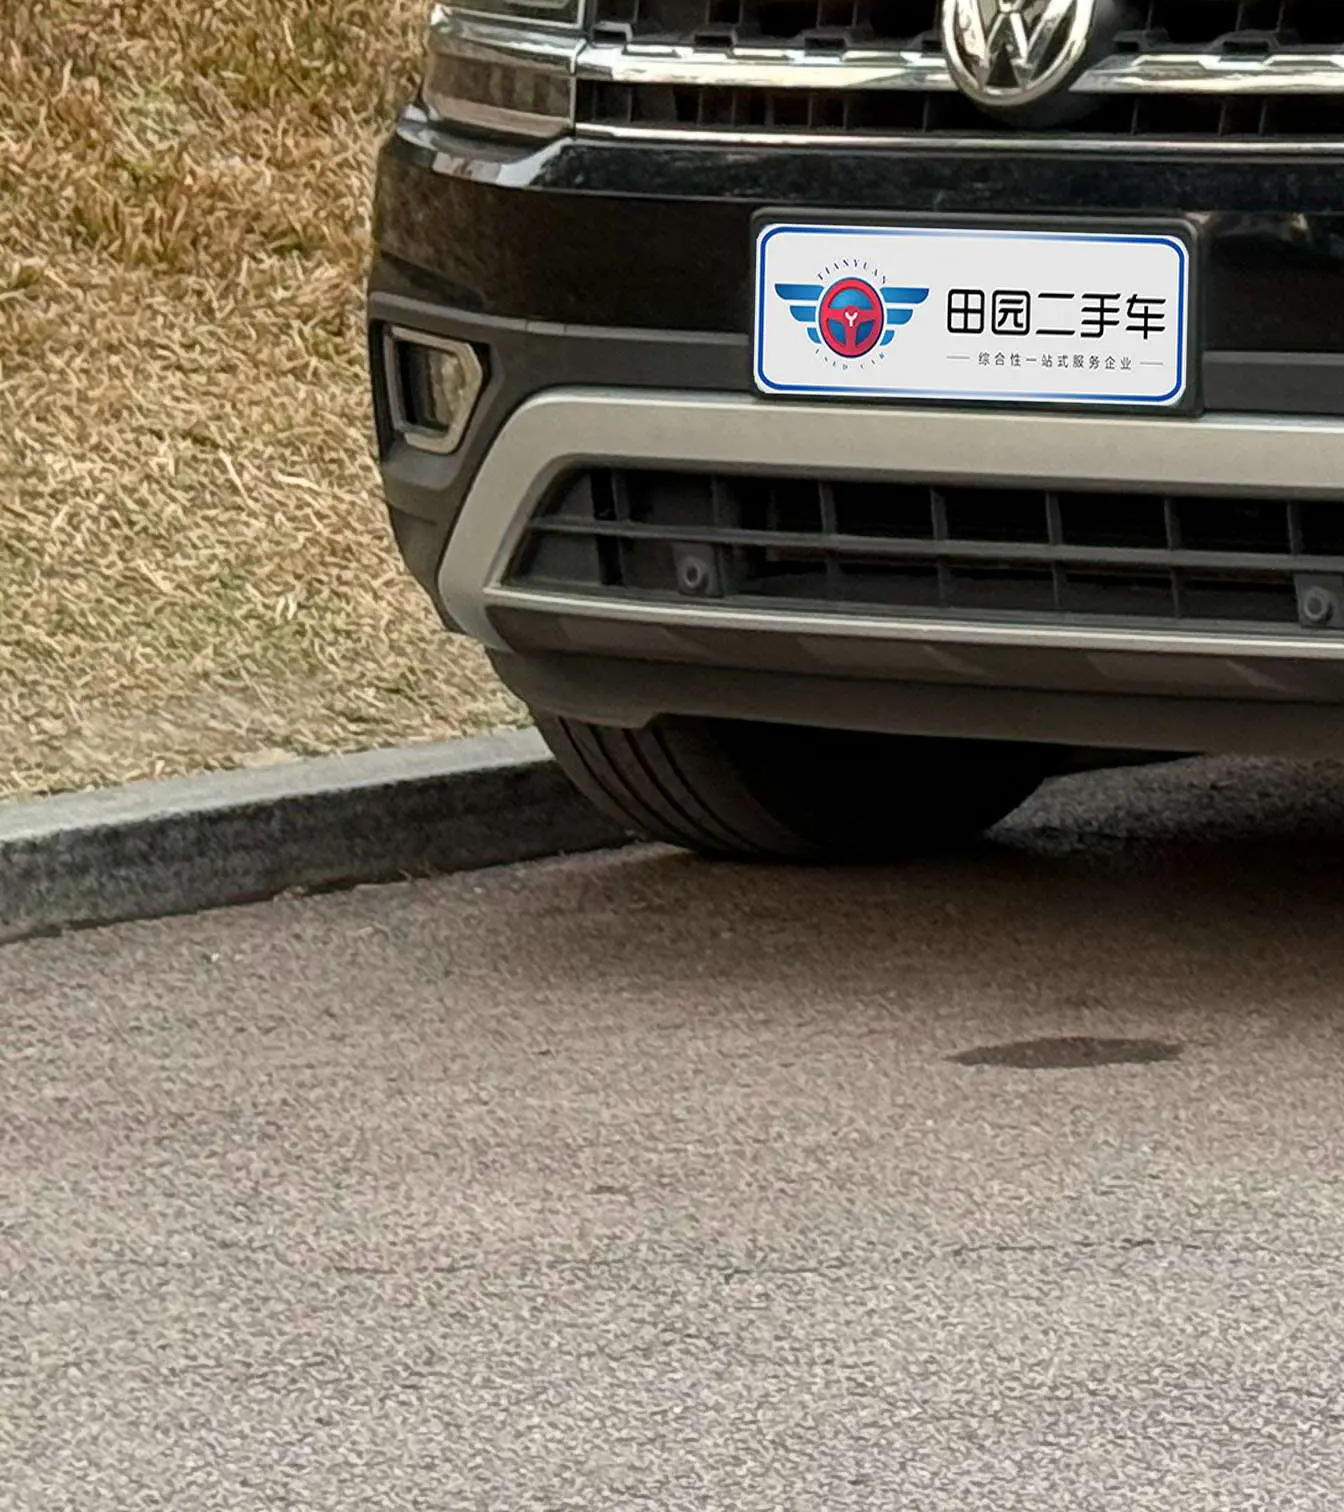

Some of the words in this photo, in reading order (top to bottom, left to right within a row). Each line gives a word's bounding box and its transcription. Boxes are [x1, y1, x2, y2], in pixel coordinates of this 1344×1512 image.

[947, 288, 1167, 340] 田园二手车
[977, 351, 1133, 371] 综合性一站式服务企业
